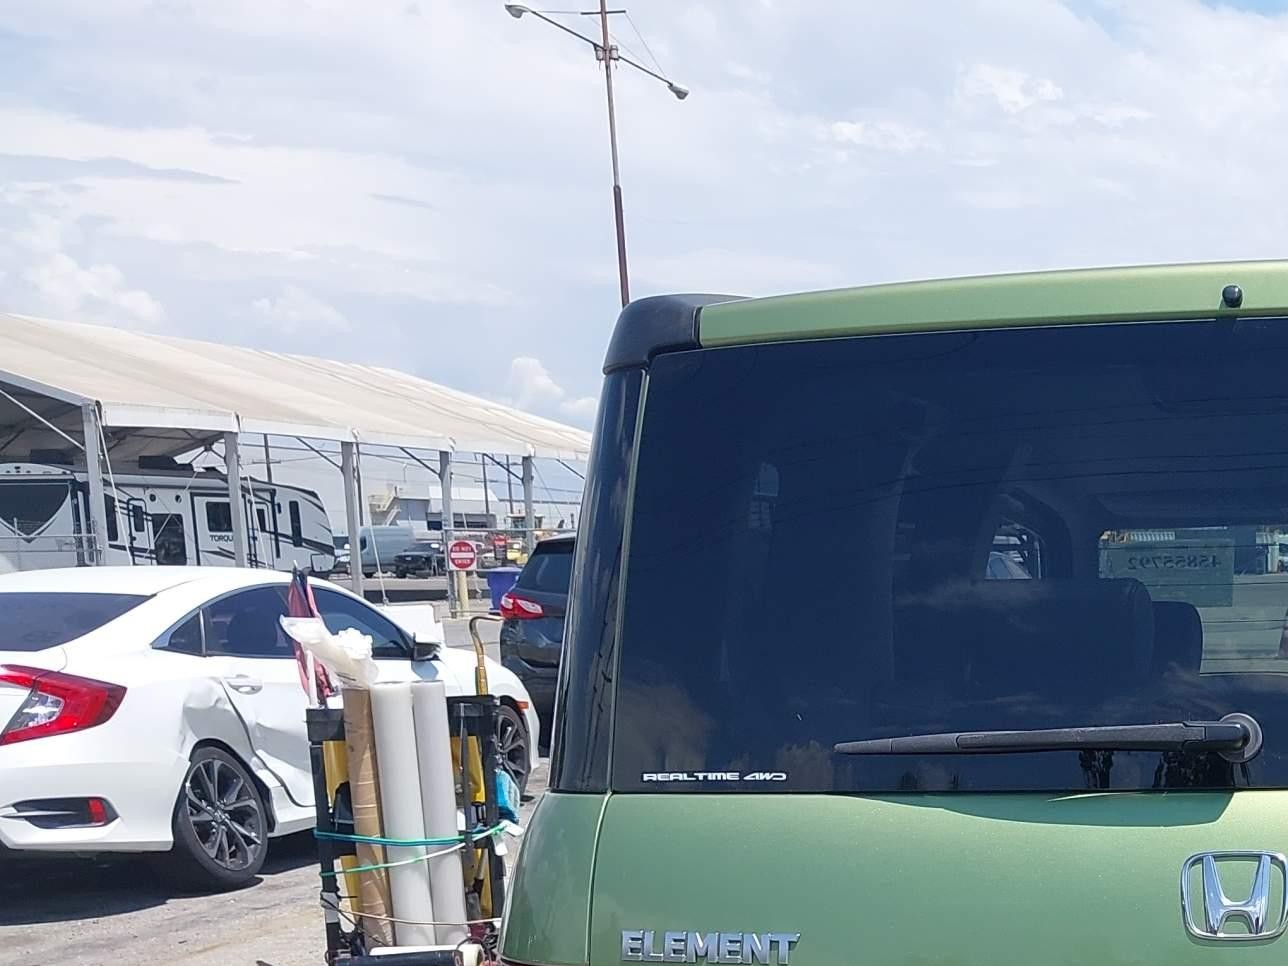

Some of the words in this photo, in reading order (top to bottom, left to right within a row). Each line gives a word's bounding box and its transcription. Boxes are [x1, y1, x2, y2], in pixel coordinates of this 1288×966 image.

[209, 534, 234, 542] TORQU
[643, 772, 740, 781] REALTIME
[621, 930, 801, 966] ELEMENT
